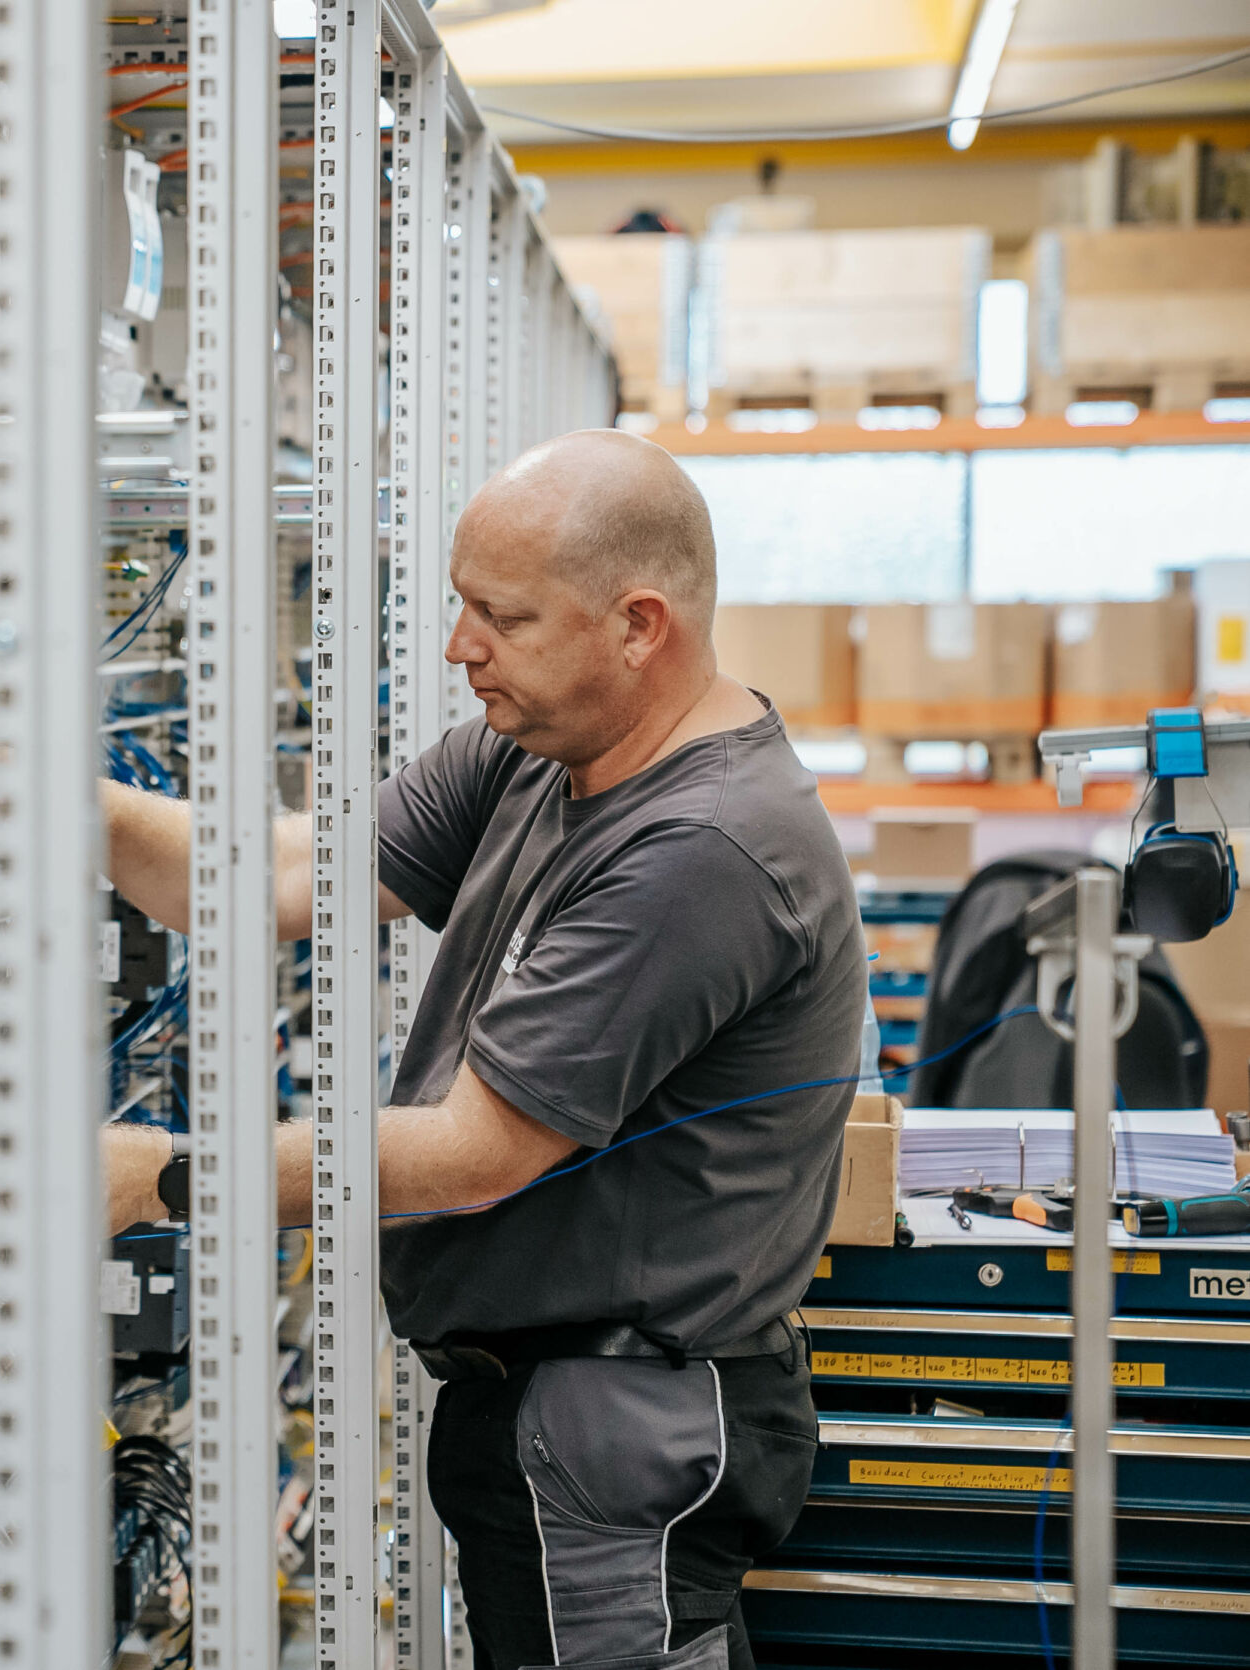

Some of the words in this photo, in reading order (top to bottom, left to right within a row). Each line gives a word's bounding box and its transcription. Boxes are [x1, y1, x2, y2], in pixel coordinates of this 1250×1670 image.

[1193, 1275, 1250, 1297] me
[859, 1467, 911, 1479] Residual
[920, 1470, 965, 1482] Current
[971, 1472, 1024, 1483] protective
